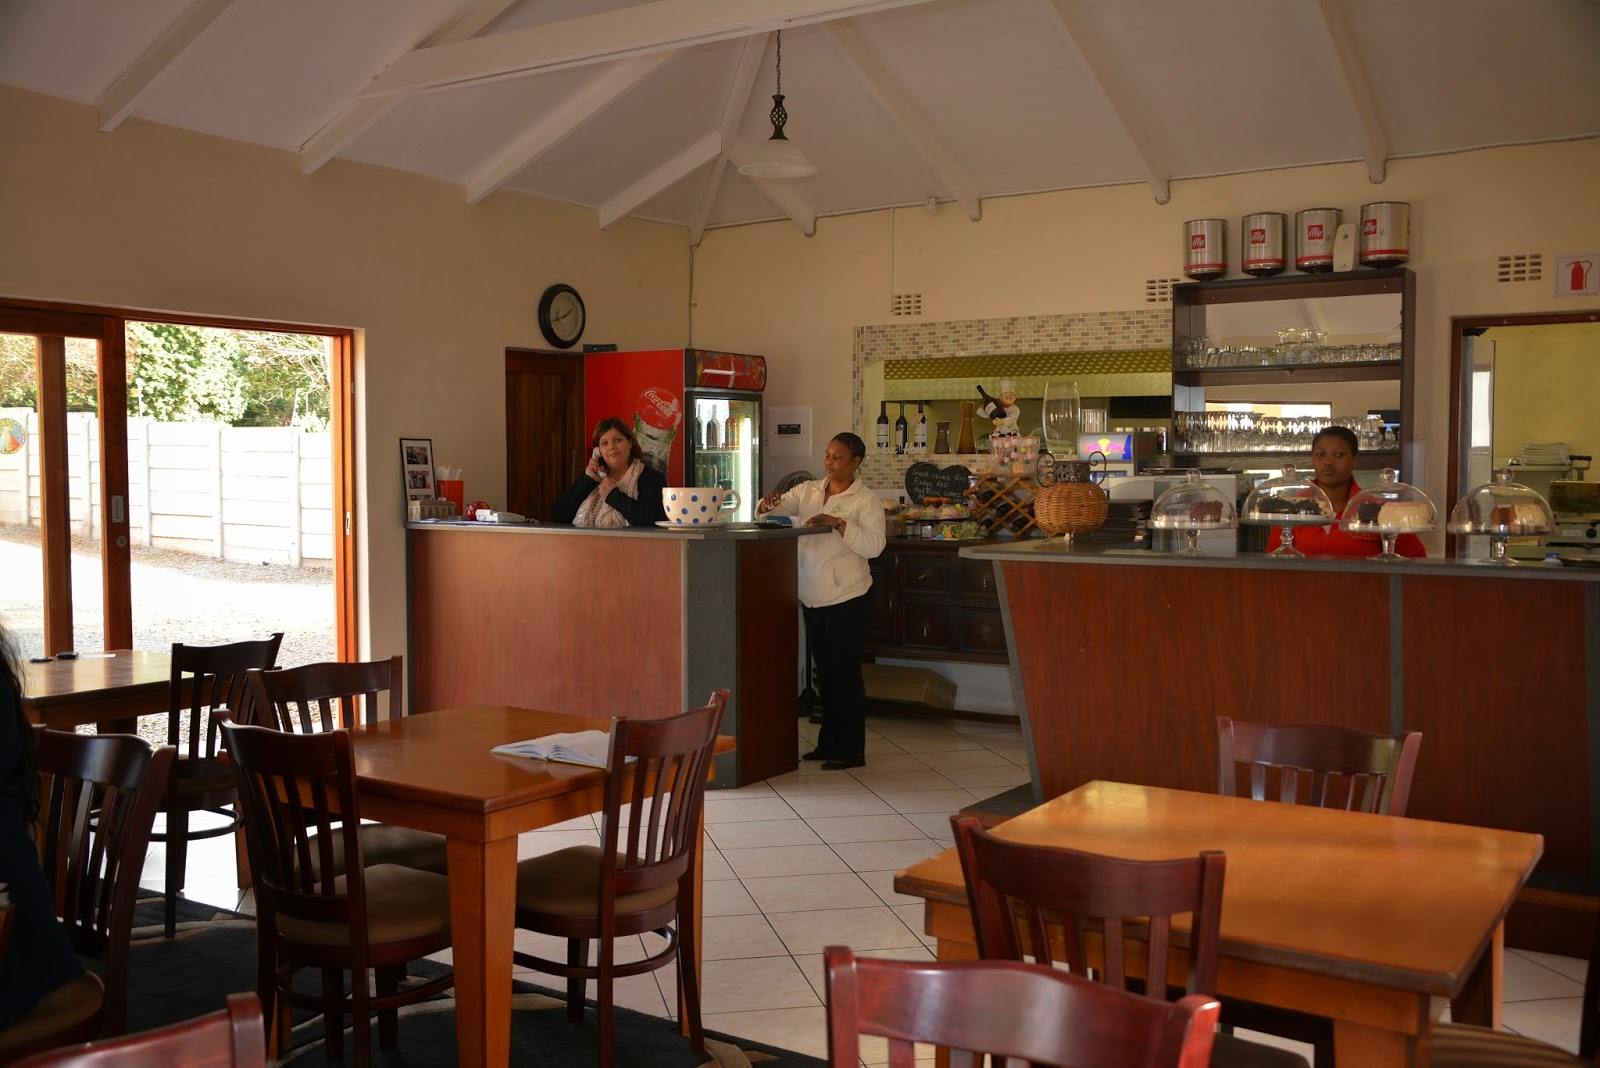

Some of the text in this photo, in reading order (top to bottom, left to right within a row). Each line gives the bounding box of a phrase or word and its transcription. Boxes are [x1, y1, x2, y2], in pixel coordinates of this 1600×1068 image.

[1308, 227, 1323, 239] illy
[1364, 222, 1377, 234] illy
[1192, 237, 1205, 248] illy
[1251, 231, 1265, 243] illy
